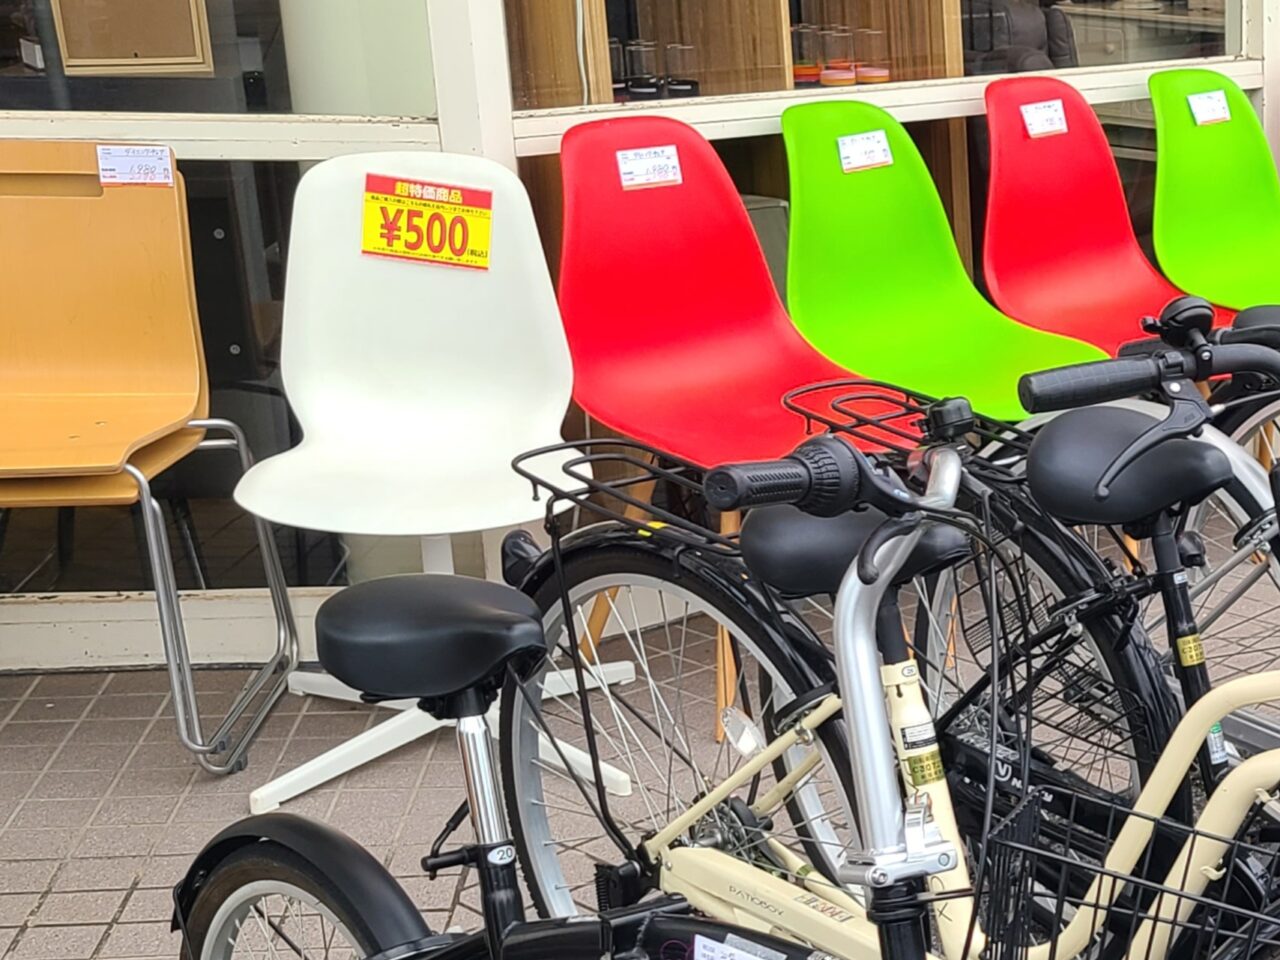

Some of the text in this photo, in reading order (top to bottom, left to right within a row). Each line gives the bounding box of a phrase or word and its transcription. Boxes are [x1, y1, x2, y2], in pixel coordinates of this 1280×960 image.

[394, 181, 463, 204] 超特価商品
[379, 206, 469, 257] ¥500
[496, 847, 513, 861] 20
[728, 884, 785, 917] PATIOBOY
